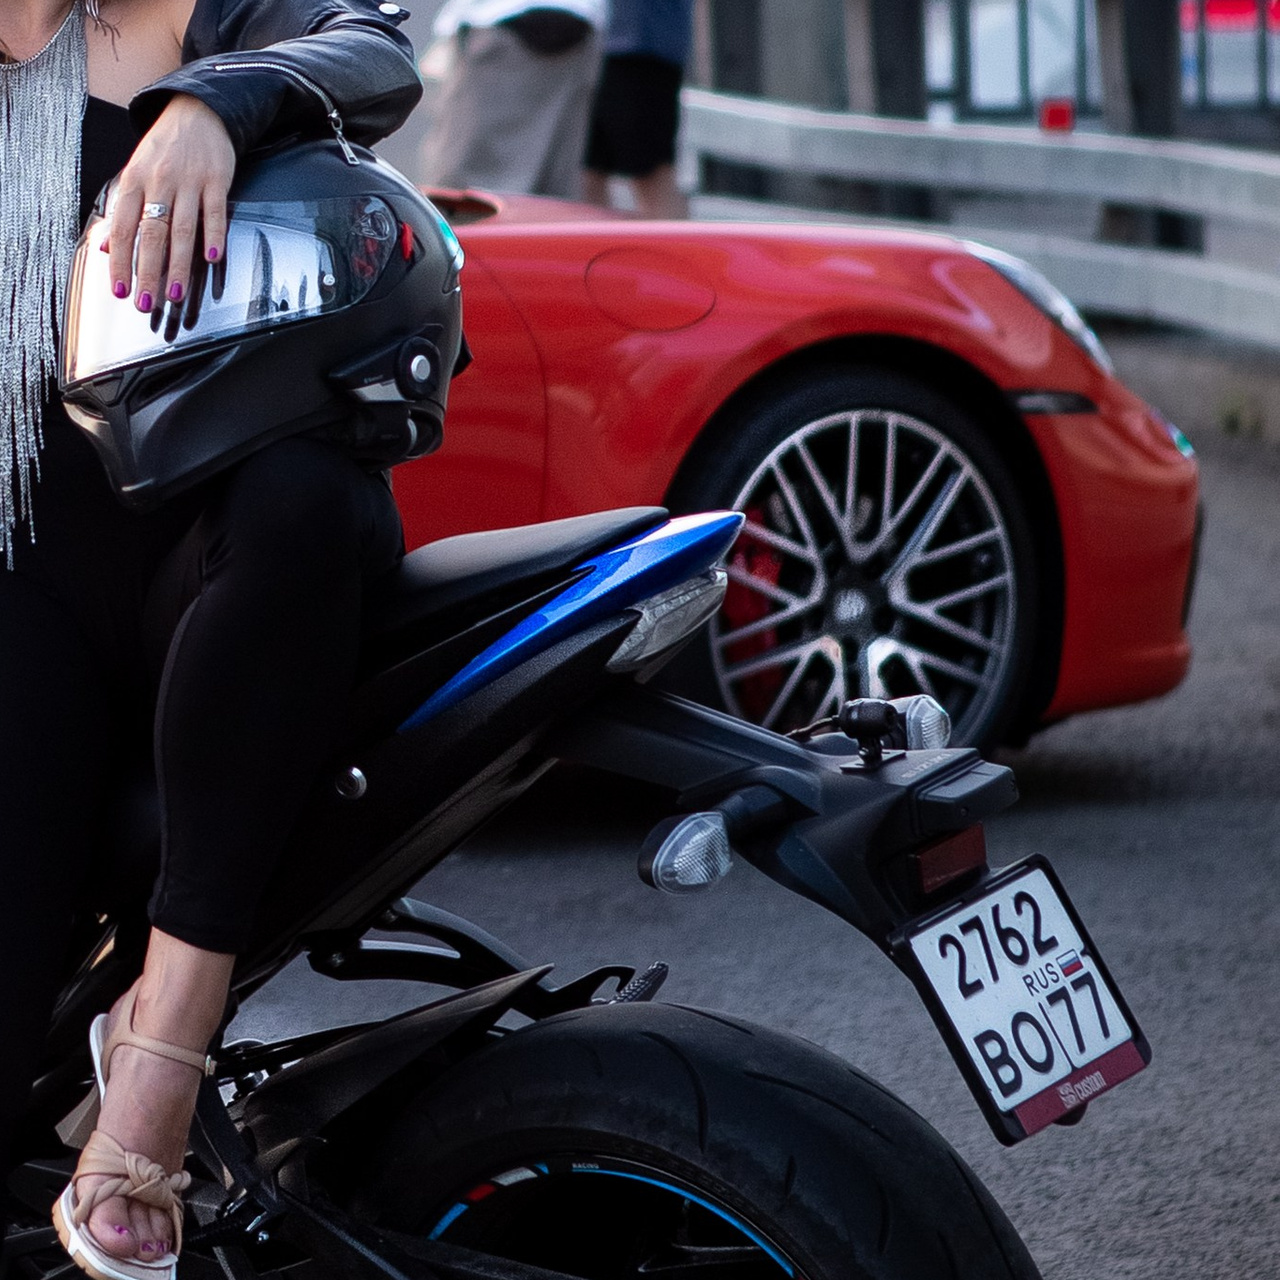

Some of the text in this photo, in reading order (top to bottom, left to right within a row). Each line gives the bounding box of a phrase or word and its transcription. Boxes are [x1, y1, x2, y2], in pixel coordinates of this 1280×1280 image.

[938, 890, 1060, 1000] 2762
[1022, 962, 1061, 998] RUS
[1045, 970, 1112, 1056] 77
[571, 1161, 600, 1171] RACING
